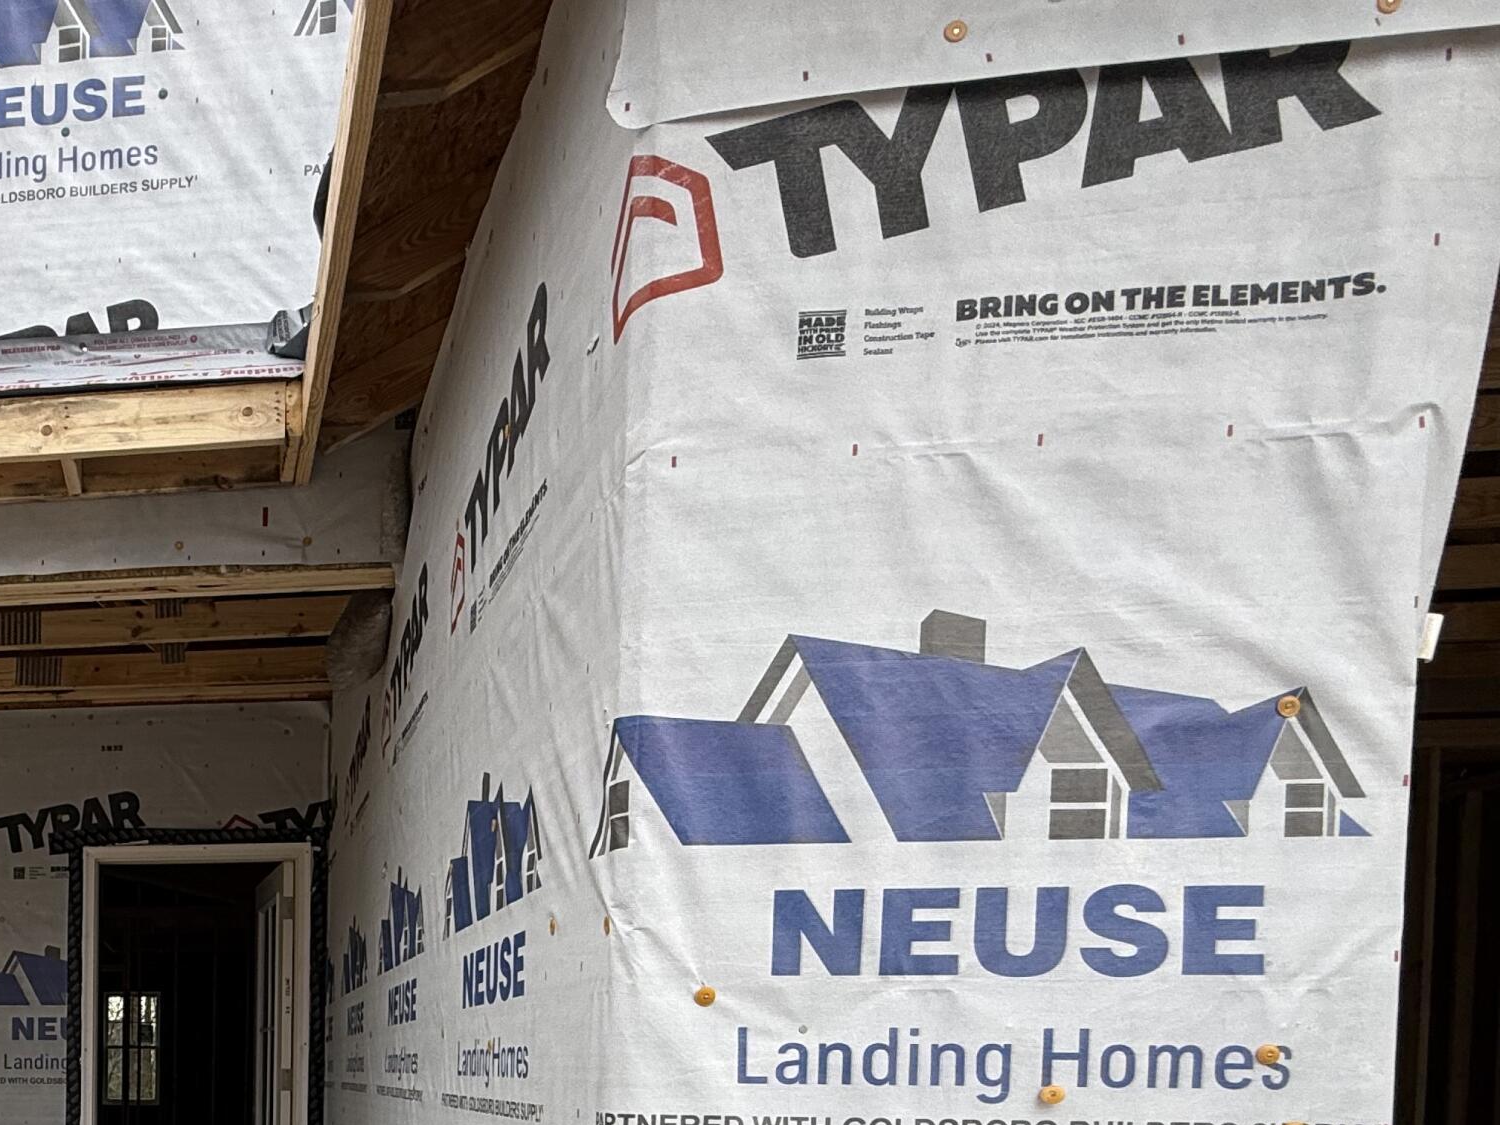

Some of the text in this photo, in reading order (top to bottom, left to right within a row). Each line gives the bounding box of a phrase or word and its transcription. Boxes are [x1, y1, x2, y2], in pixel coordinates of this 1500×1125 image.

[58, 143, 159, 174] Homes
[704, 41, 1382, 258] TYPAR
[69, 182, 138, 198] BUILDERS
[865, 306, 923, 317] Building Wraps
[956, 272, 1387, 321] BRING ON THE ELEMENTS.
[798, 334, 845, 345] IN OLD
[799, 317, 846, 328] MADE
[864, 322, 901, 330] Flashings
[864, 332, 935, 342] Construction Tape
[465, 282, 551, 575] TYPAR
[390, 561, 428, 724] TYPAR
[770, 883, 1265, 977] NEUSE
[462, 930, 526, 1009] NEUSE
[388, 978, 417, 1027] NEUSE
[457, 1037, 529, 1088] Landing Homes
[736, 1027, 1292, 1104] Landing Homes
